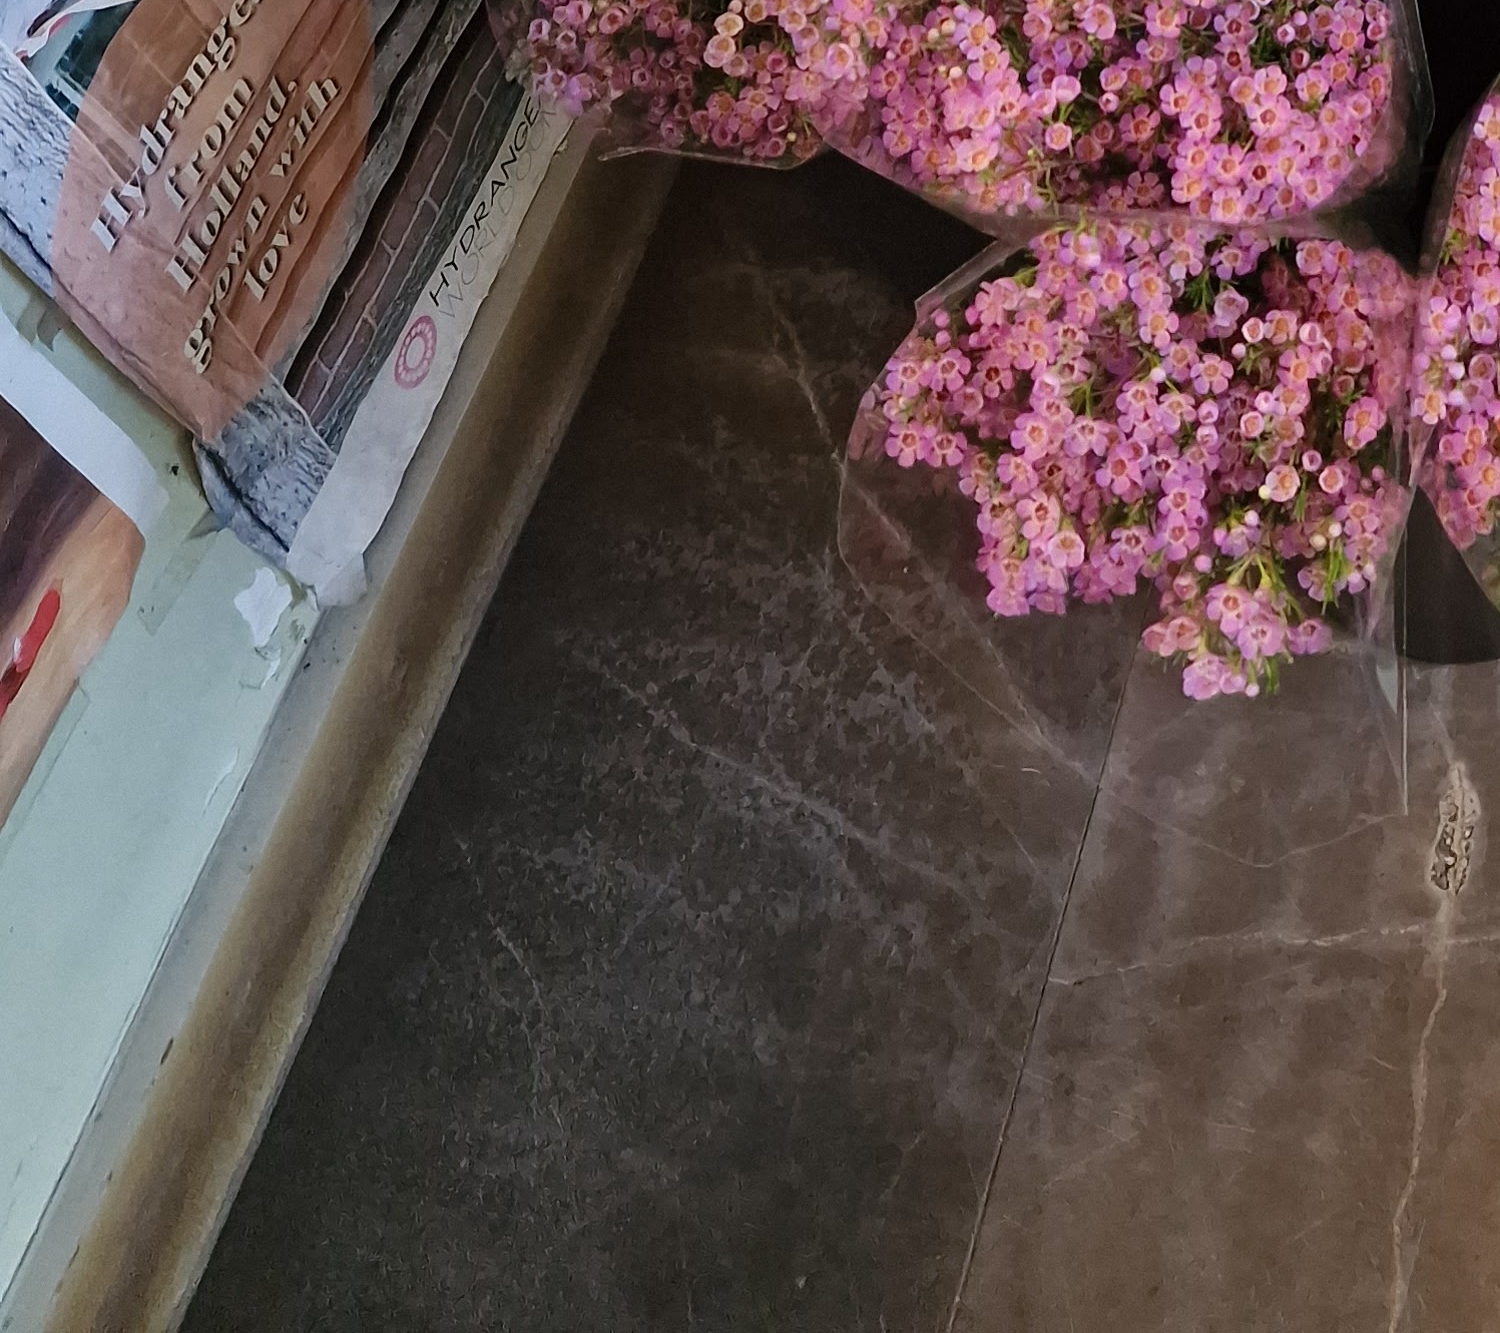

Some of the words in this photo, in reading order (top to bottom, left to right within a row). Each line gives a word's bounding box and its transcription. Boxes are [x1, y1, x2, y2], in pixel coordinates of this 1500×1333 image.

[163, 76, 255, 212] from
[183, 195, 269, 374] grown
[269, 76, 341, 178] with
[429, 94, 542, 308] HYDRANGE
[243, 191, 309, 302] love
